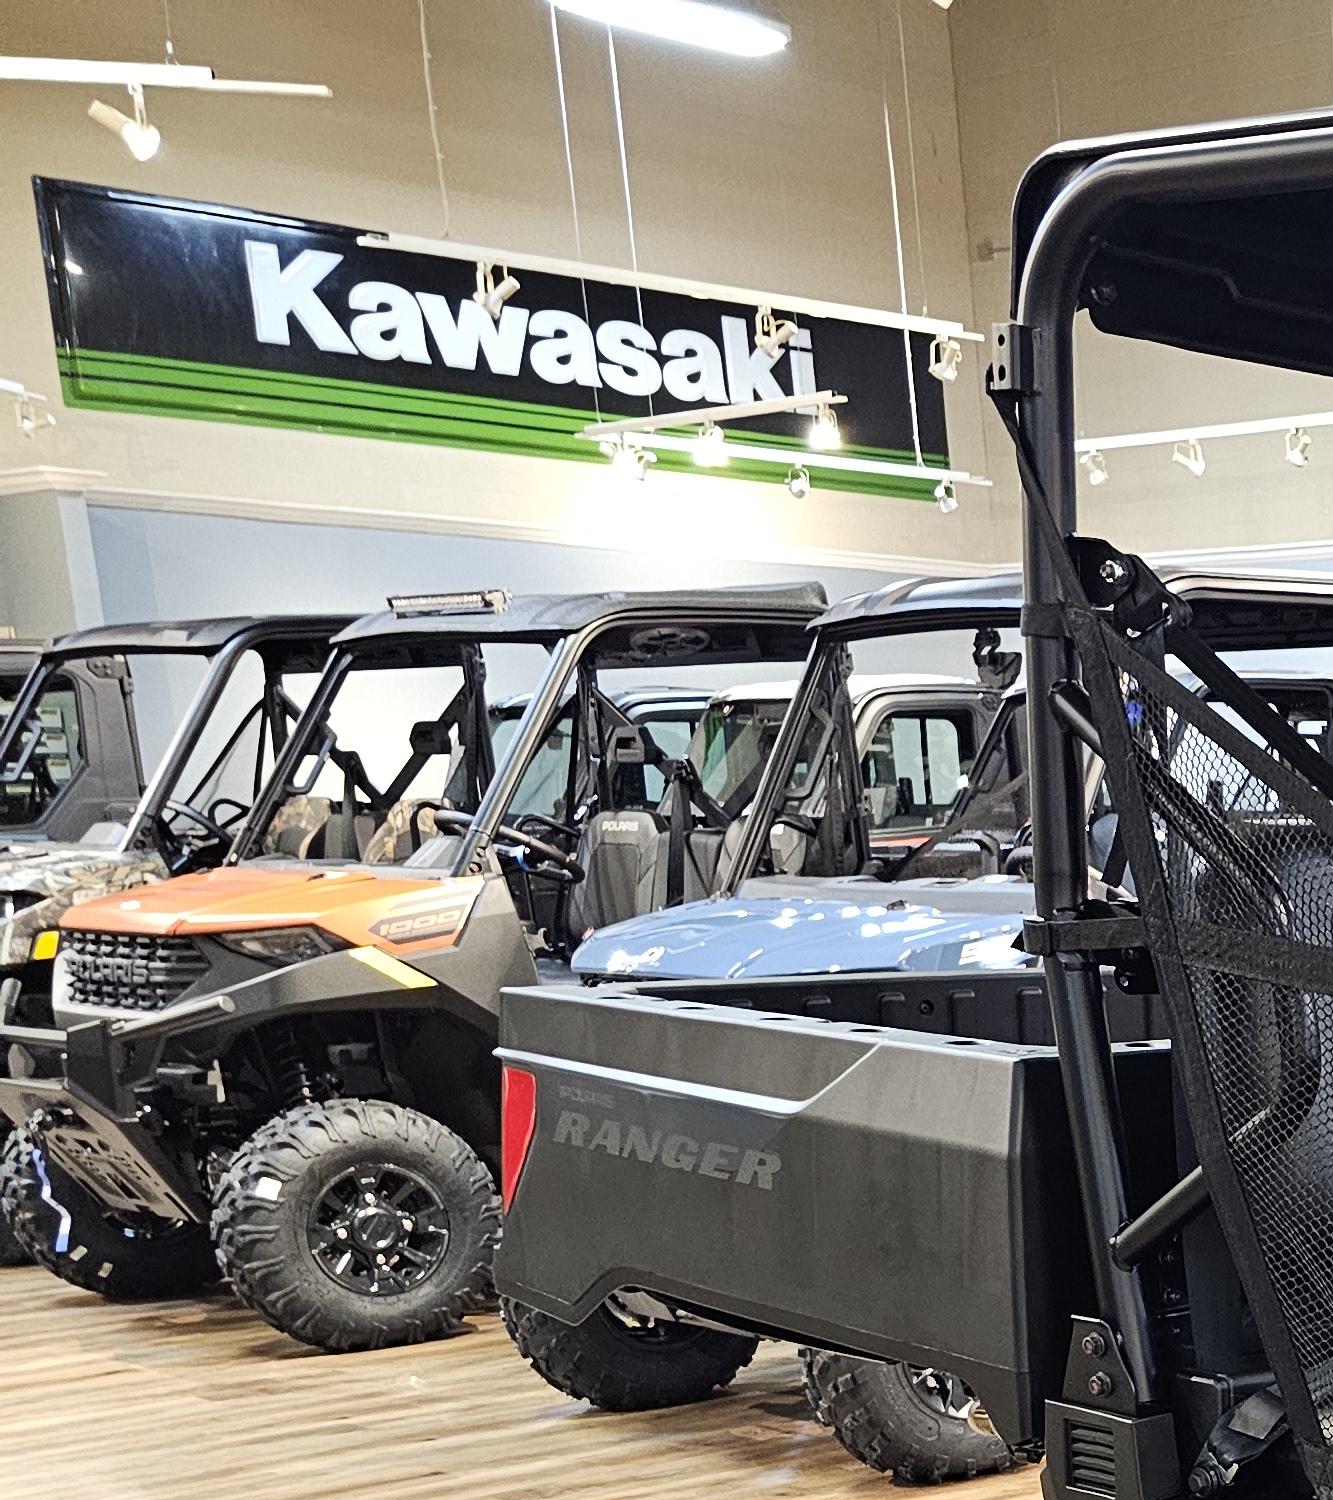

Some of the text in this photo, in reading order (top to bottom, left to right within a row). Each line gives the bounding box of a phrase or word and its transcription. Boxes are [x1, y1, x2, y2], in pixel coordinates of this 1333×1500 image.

[244, 240, 817, 415] Kawasaki
[602, 820, 640, 832] POLARIS
[379, 910, 462, 936] 1000
[553, 1110, 782, 1190] RANGER
